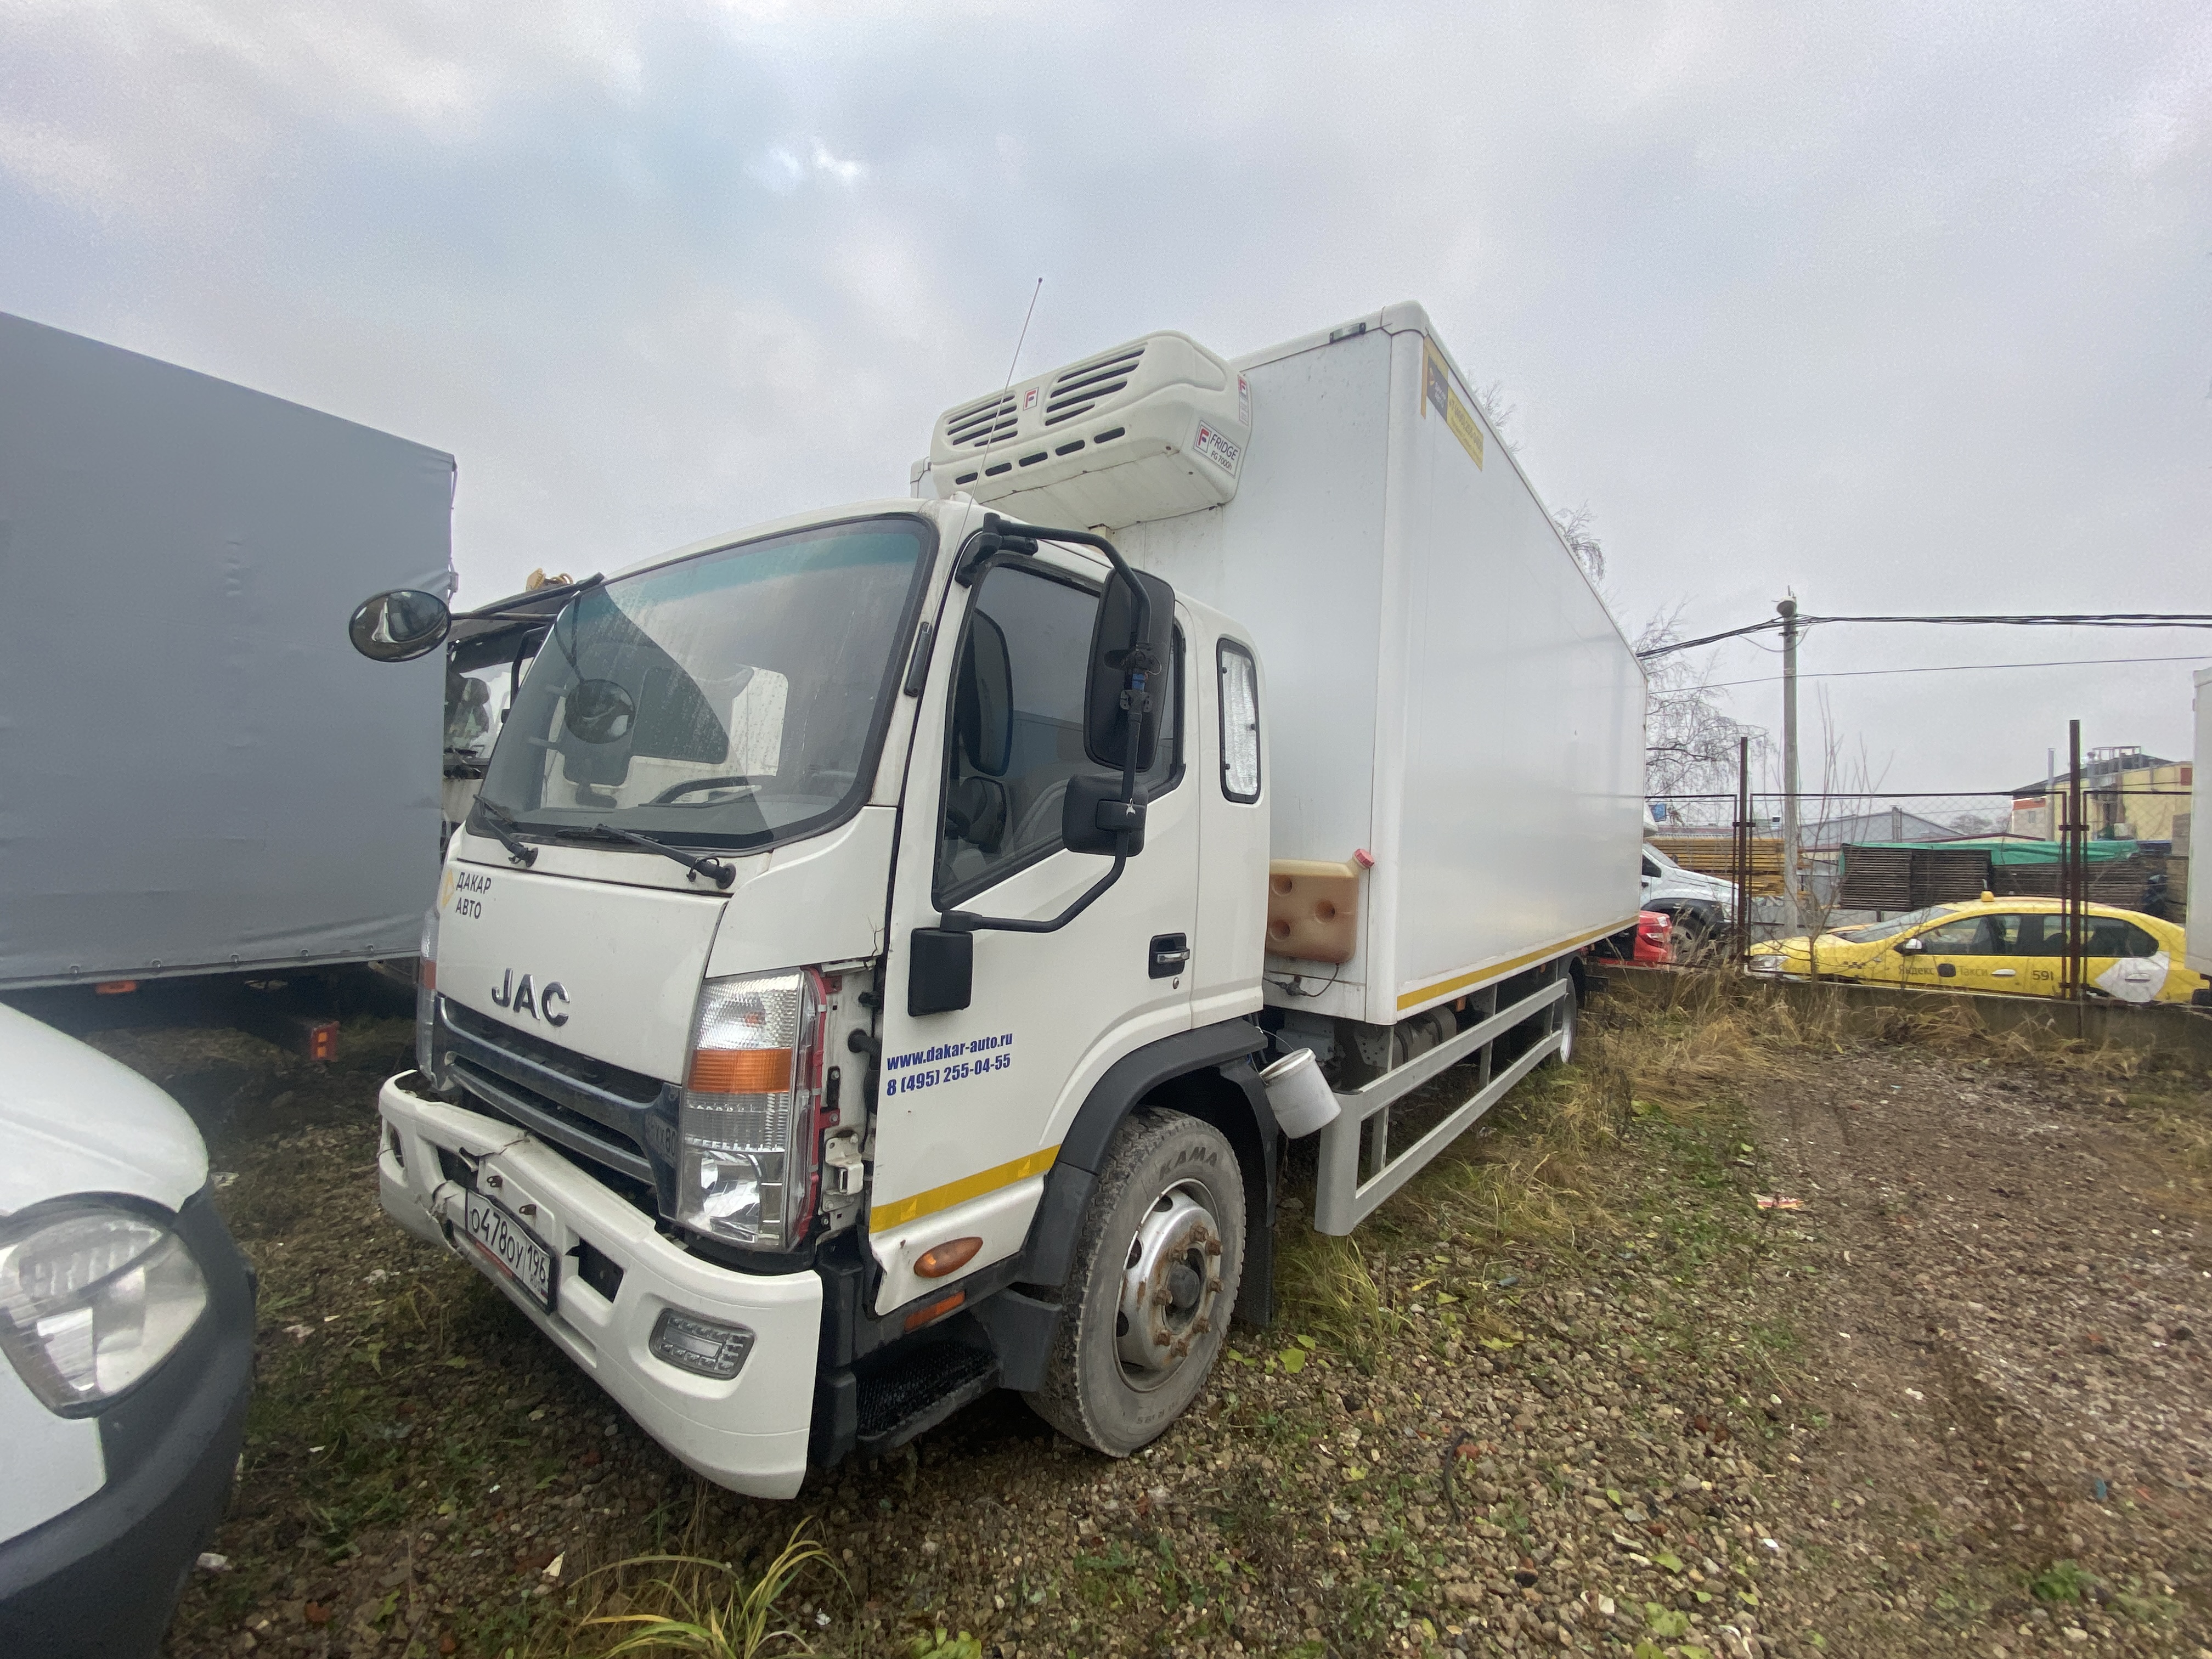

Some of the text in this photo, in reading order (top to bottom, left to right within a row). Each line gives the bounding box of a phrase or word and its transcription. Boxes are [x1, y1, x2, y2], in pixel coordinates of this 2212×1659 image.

[1210, 433, 1239, 461] FRIDGE
[1211, 450, 1218, 460] FG
[455, 871, 492, 895] ДАКАР
[455, 897, 482, 919] АВТО
[492, 967, 570, 1027] JAC
[887, 1032, 1013, 1070] www.dakar-auto.ru
[887, 1053, 1011, 1096] 8 (495) 255-04-55
[1159, 1146, 1217, 1183] KAMA
